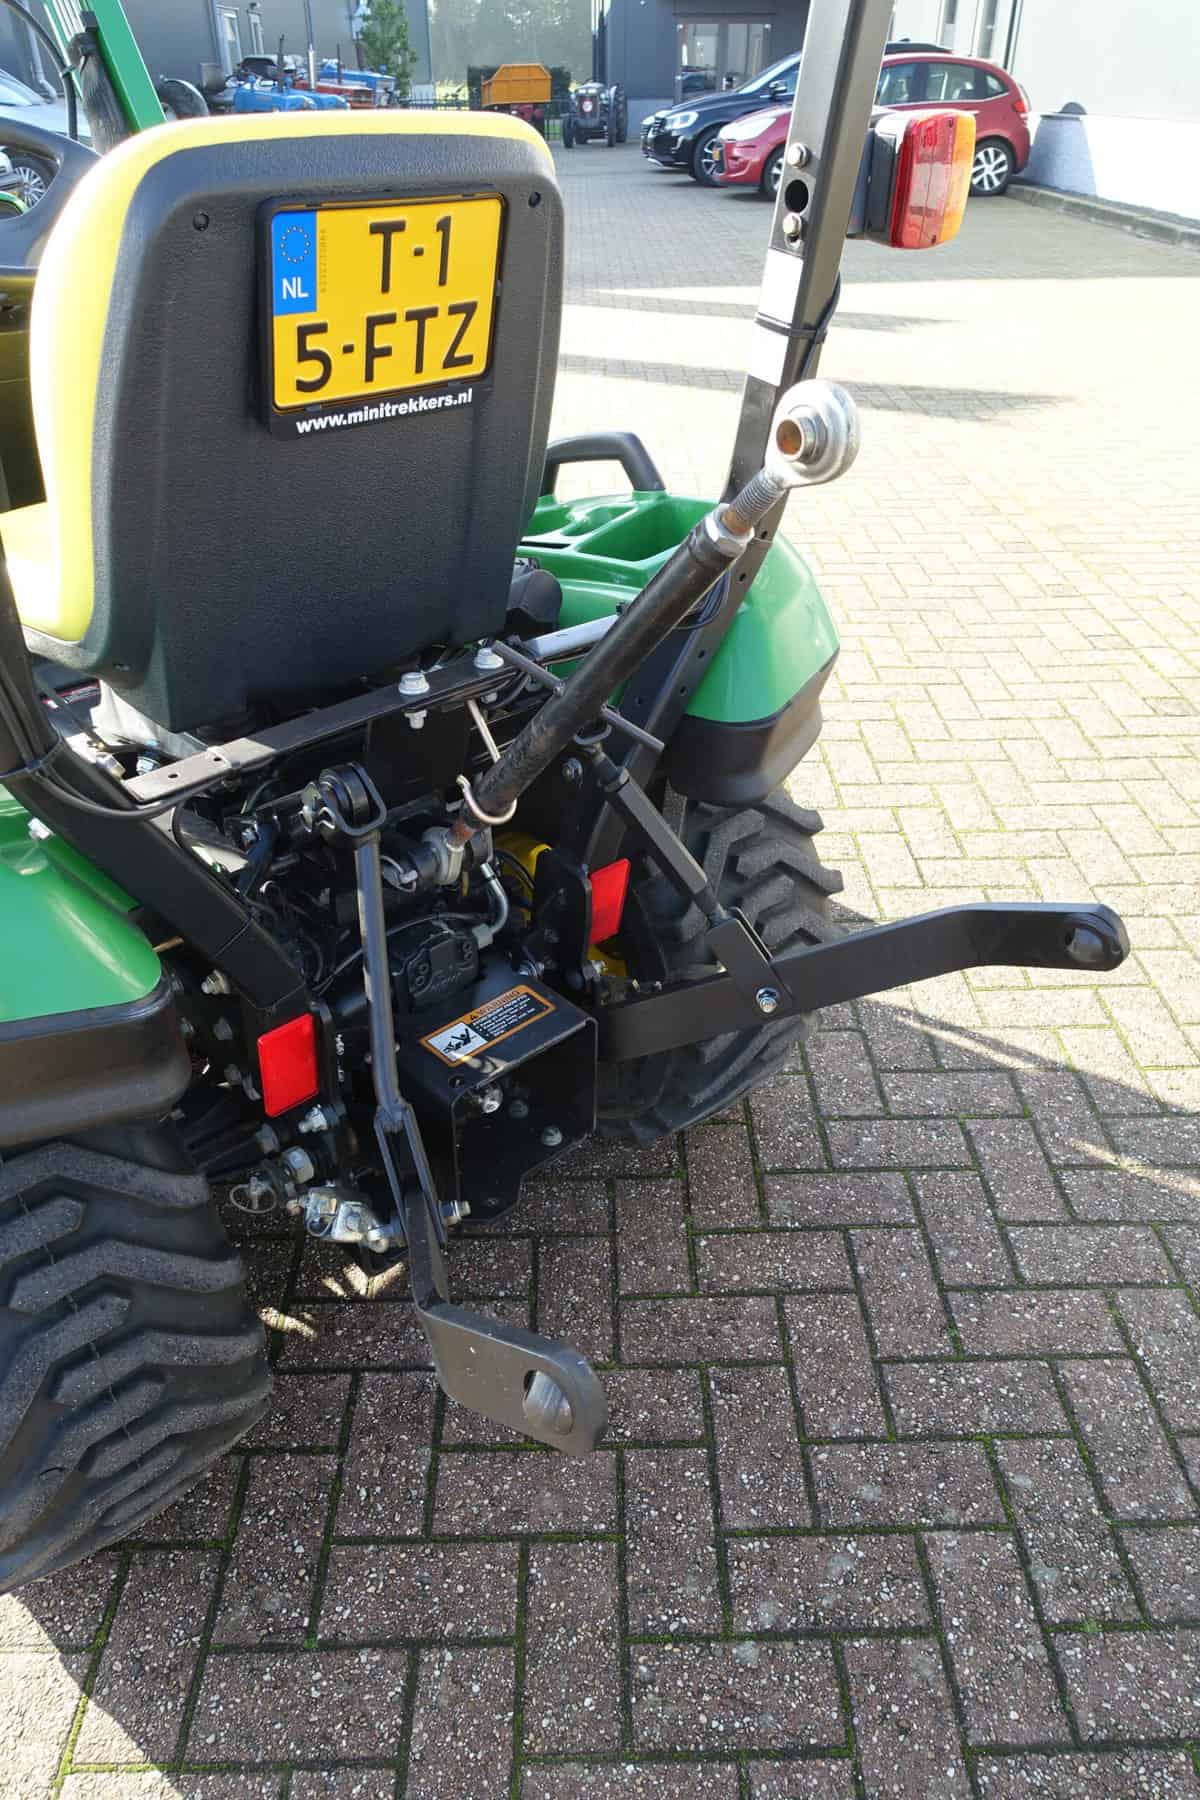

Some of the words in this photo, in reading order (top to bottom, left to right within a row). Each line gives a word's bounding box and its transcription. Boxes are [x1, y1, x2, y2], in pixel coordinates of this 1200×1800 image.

[369, 215, 452, 294] T-1
[282, 277, 309, 300] NL
[296, 300, 478, 393] 5-FTZ
[295, 388, 473, 433] www.minitrekkers.nl
[479, 990, 520, 1015] WARNING
